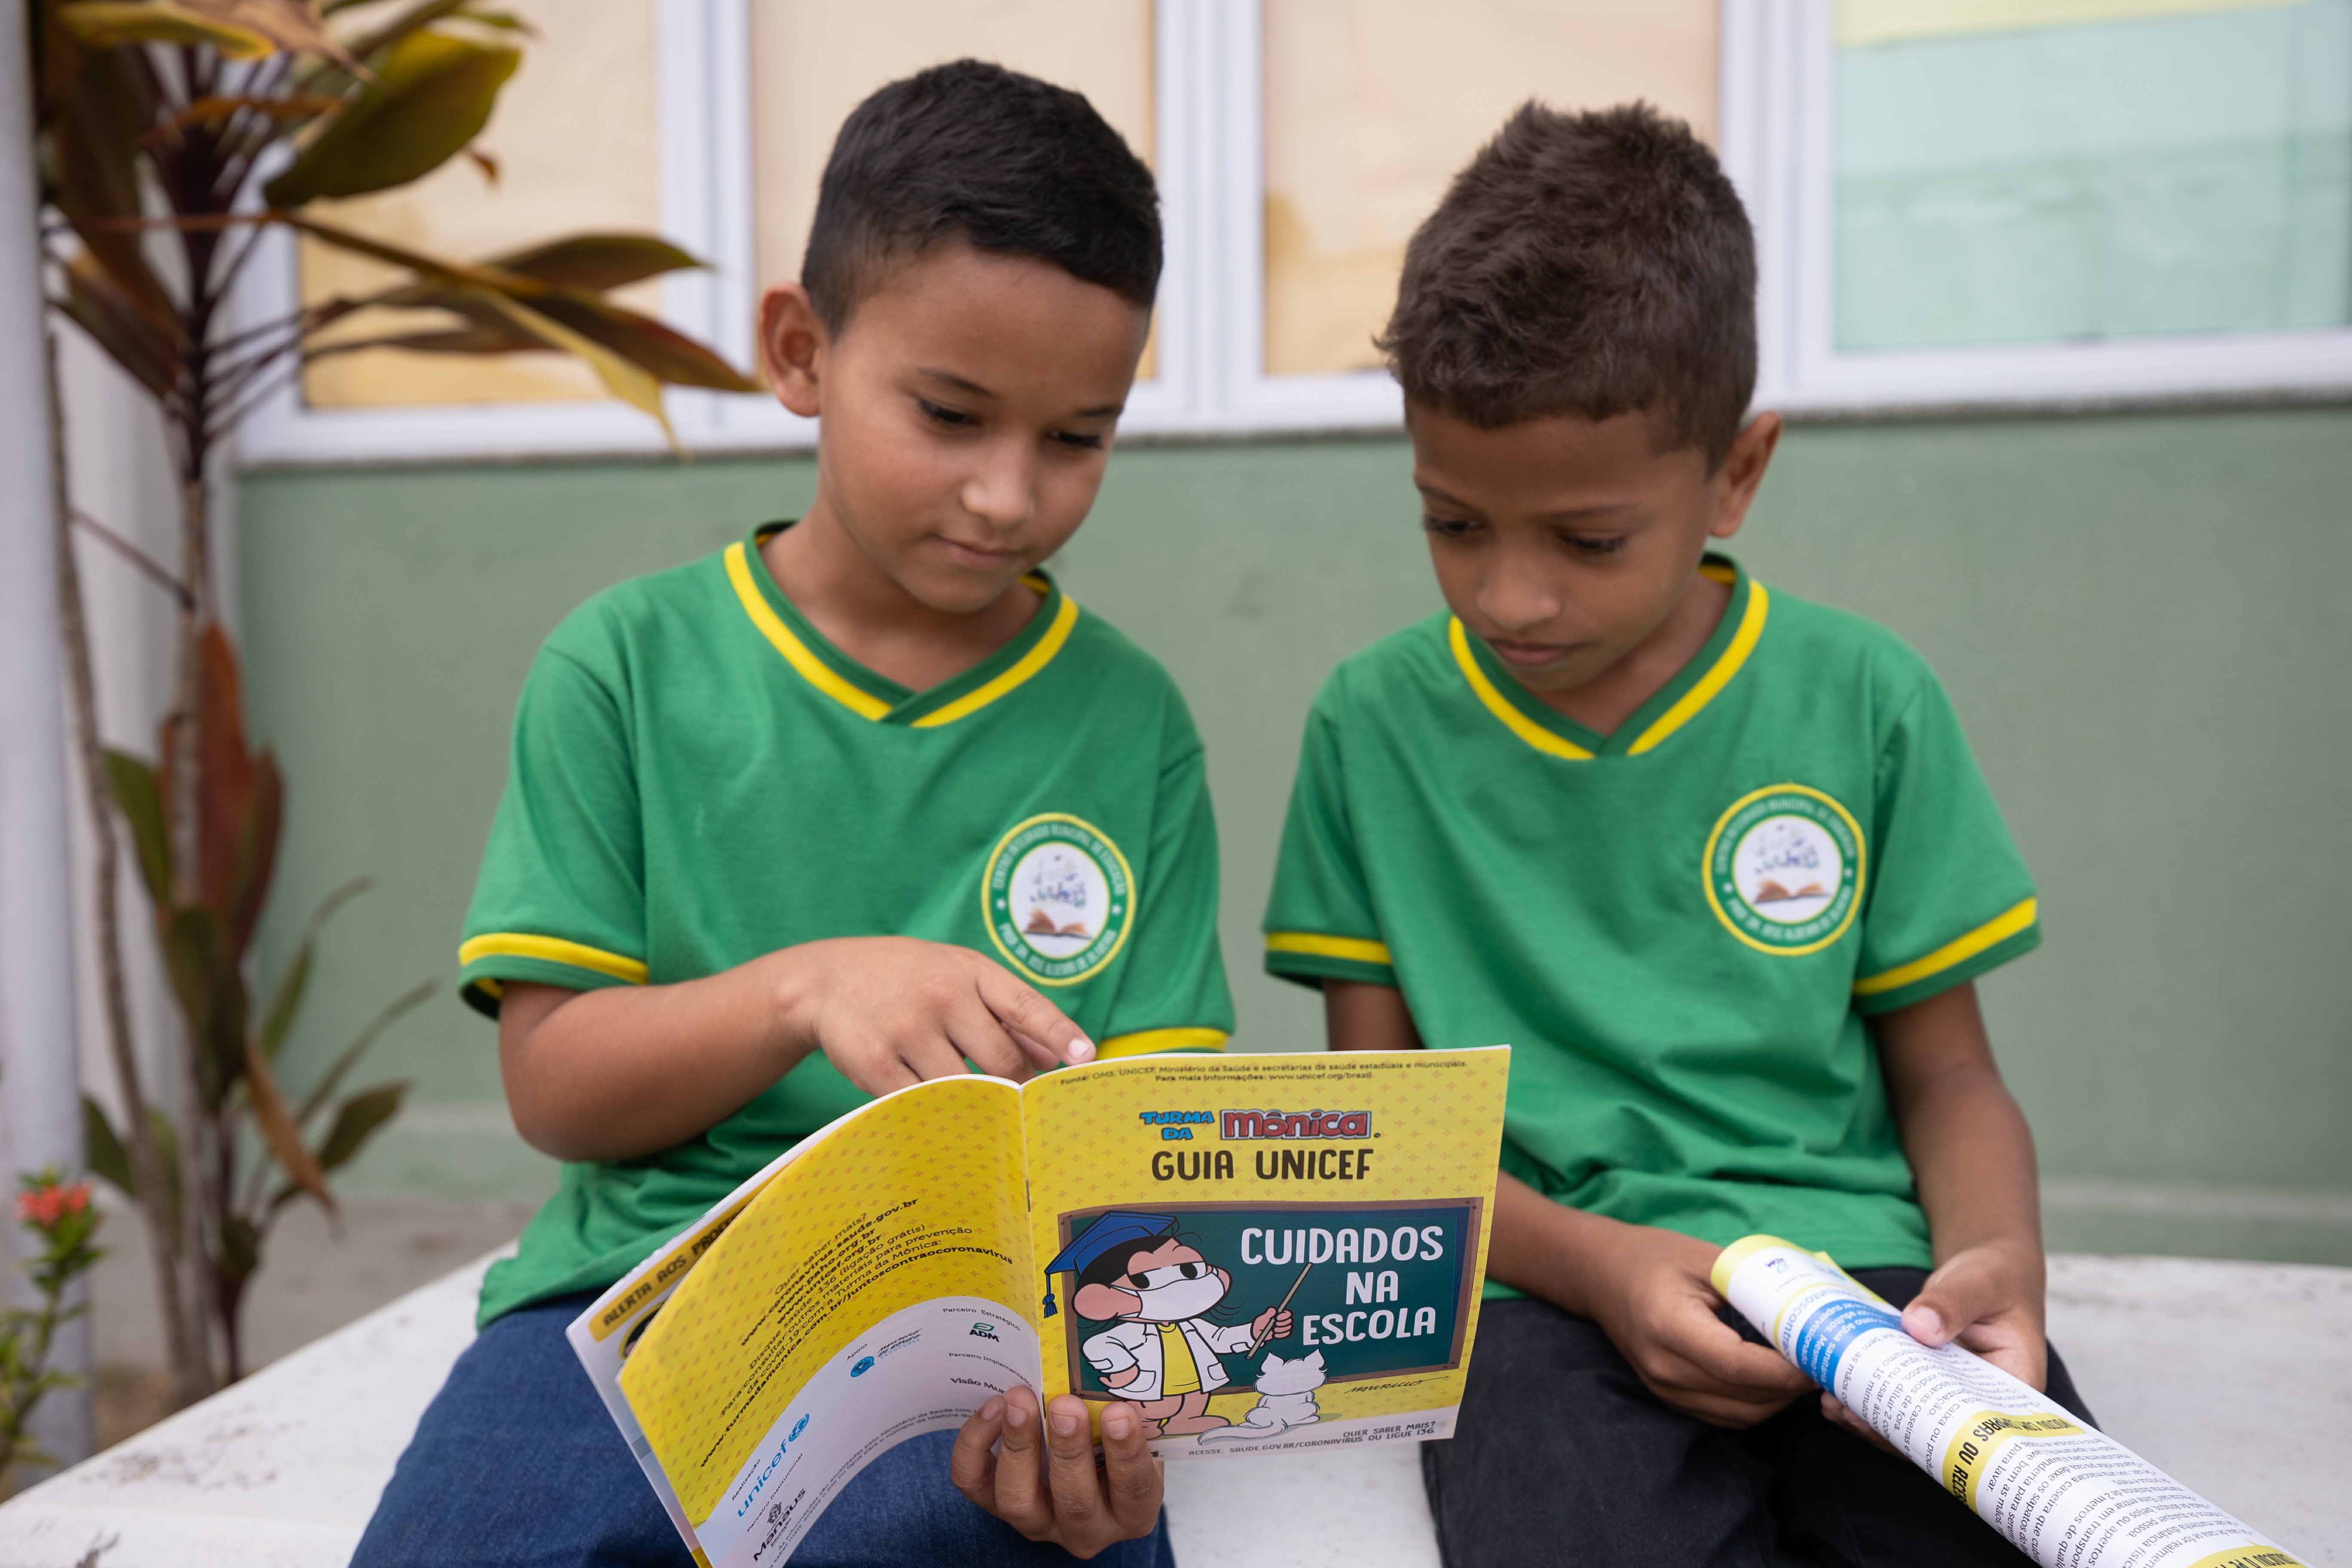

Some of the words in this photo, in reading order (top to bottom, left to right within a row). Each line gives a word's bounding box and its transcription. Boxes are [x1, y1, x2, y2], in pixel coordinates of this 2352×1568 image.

[1139, 1110, 1215, 1125] TURMA
[1161, 1126, 1194, 1141] DA
[1152, 1151, 1234, 1181] GUIA
[1256, 1148, 1374, 1180] UNICEF
[774, 1267, 800, 1295] Quer
[802, 1238, 832, 1267] saber
[834, 1213, 867, 1243] mais?
[1240, 1226, 1444, 1265] CUIDADOS
[741, 1198, 919, 1347] www.coronavirus.saude.gov.br
[777, 1228, 876, 1314] www.paho.org.br
[777, 1234, 882, 1324] www.unicef.org.br
[603, 1281, 652, 1326] ALERTA
[656, 1255, 687, 1283] AOS
[749, 1329, 781, 1369] Disque
[783, 1294, 816, 1329] saúde:
[817, 1276, 837, 1295] 136
[839, 1243, 884, 1277] (ligação
[887, 1224, 925, 1246] grátis)
[1345, 1271, 1398, 1305] NA
[721, 1390, 742, 1416] Para
[744, 1333, 787, 1388] consultar
[788, 1299, 820, 1333] outros
[822, 1259, 873, 1301] materiais
[876, 1243, 901, 1264] para
[904, 1226, 972, 1247] prevenção
[747, 1379, 759, 1394] da
[760, 1329, 799, 1378] covid-19
[801, 1305, 826, 1329] com
[834, 1270, 872, 1298] Turma
[875, 1259, 890, 1270] da
[892, 1239, 942, 1262] Mônica:
[981, 1309, 1020, 1331] Estratégico
[1302, 1307, 1436, 1346] ESCOLA
[969, 1329, 1000, 1343] ADM
[847, 1344, 867, 1361] Apoio
[1851, 1351, 1862, 1363] as
[950, 1378, 981, 1386] Visão
[1841, 1363, 1854, 1391] mãos
[1873, 1367, 1884, 1380] 15
[1887, 1367, 1900, 1378] ou
[1876, 1380, 1889, 1403] usar
[1886, 1383, 1903, 1411] diluir
[1900, 1395, 1912, 1409] de
[1373, 1426, 1401, 1434] SABER
[1406, 1421, 1436, 1430] MAIS?
[1884, 1411, 1892, 1419] 2
[1894, 1409, 1905, 1430] fora.
[1904, 1405, 1921, 1444] caseiras
[1938, 1403, 1960, 1427] caixa
[1386, 1430, 1412, 1439] LIGUE
[1417, 1427, 1434, 1436] 136
[1929, 1428, 1940, 1442] ou
[1959, 1441, 1979, 1466] OU
[2001, 1443, 2022, 1464] para
[732, 1459, 760, 1501] Realização
[738, 1439, 787, 1517] unicef
[1952, 1464, 1968, 1503] RECEB
[1986, 1465, 2006, 1492] lavar.
[2006, 1460, 2029, 1483] bem
[2047, 1467, 2070, 1481] deixe
[747, 1501, 770, 1532] Parceiro
[770, 1453, 803, 1500] Institucional
[2000, 1484, 2009, 1497] as
[2010, 1485, 2025, 1511] para
[2037, 1482, 2049, 1493] os
[2042, 1481, 2072, 1513] caseira
[2020, 1493, 2040, 1532] sapatos
[2073, 1495, 2106, 1524] metros
[2097, 1508, 2114, 1520] em
[2115, 1516, 2130, 1526] ou
[753, 1488, 805, 1562] Manaus
[2033, 1516, 2045, 1536] que
[2064, 1525, 2076, 1540] de
[2125, 1518, 2159, 1537] pessoa.
[2054, 1541, 2068, 1568] qualq
[2070, 1522, 2101, 1568] transport
[2088, 1525, 2118, 1566] apertos
